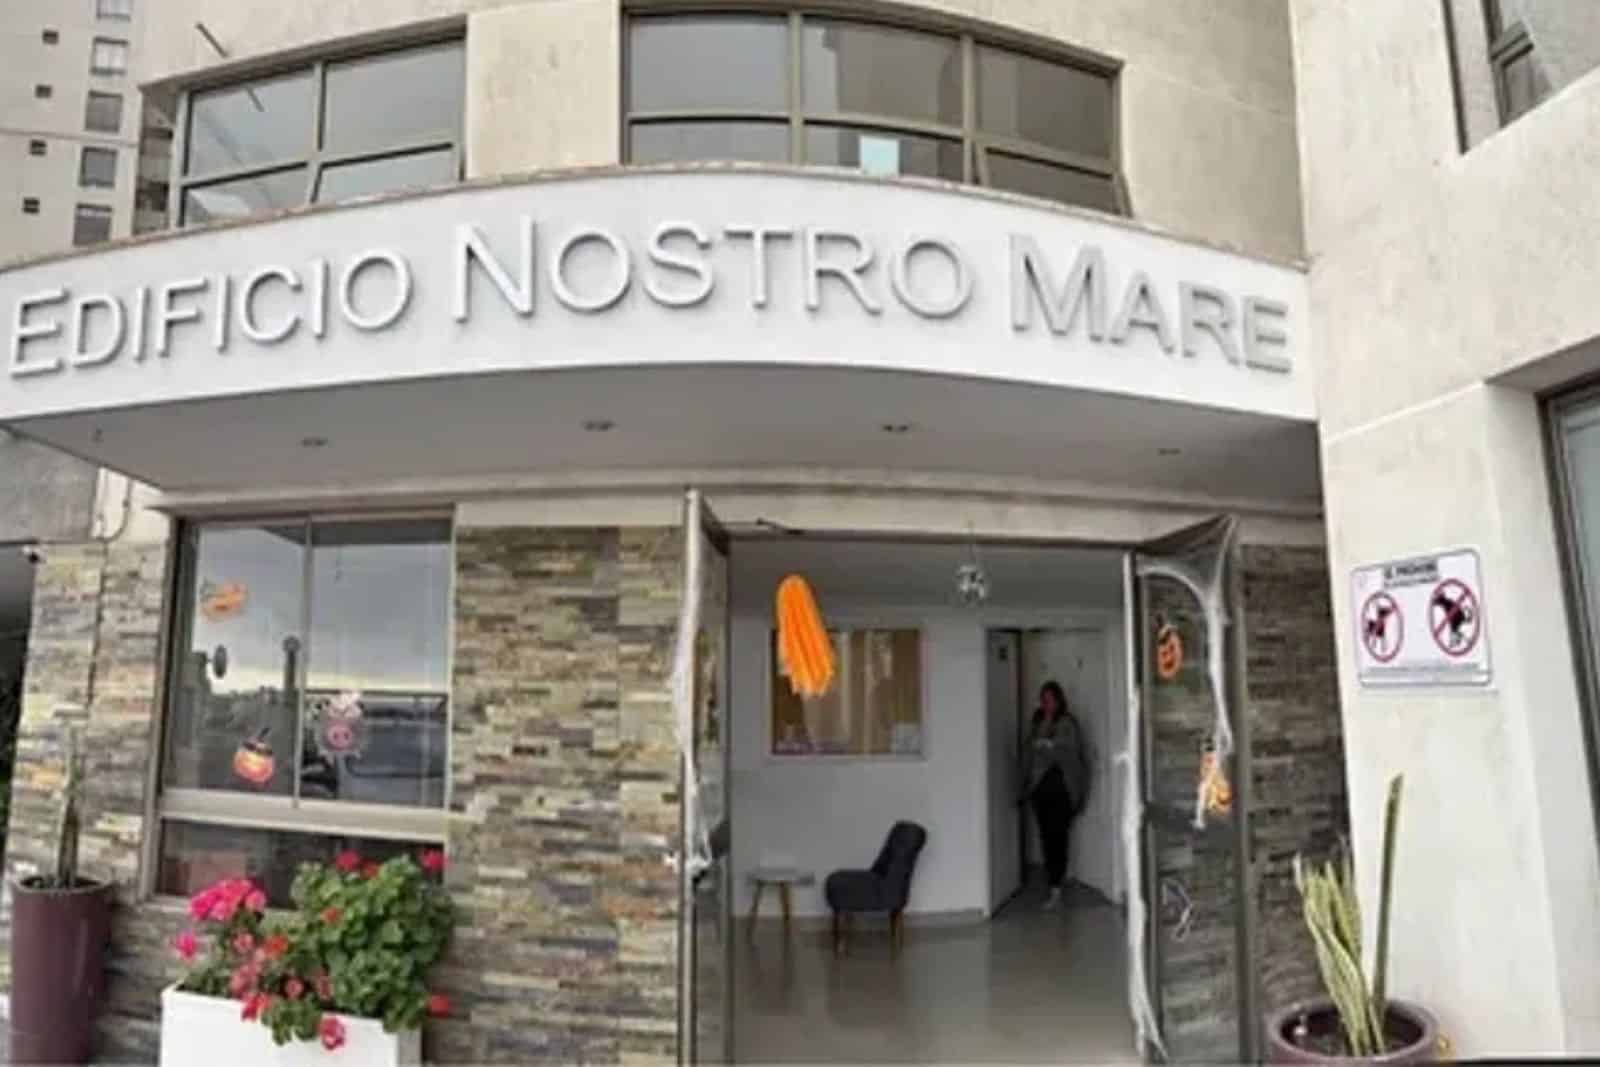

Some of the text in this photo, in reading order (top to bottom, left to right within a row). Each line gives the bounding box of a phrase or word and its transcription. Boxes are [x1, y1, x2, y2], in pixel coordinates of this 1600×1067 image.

[9, 214, 1294, 379] EDIFICIO NOSTRO MARE
